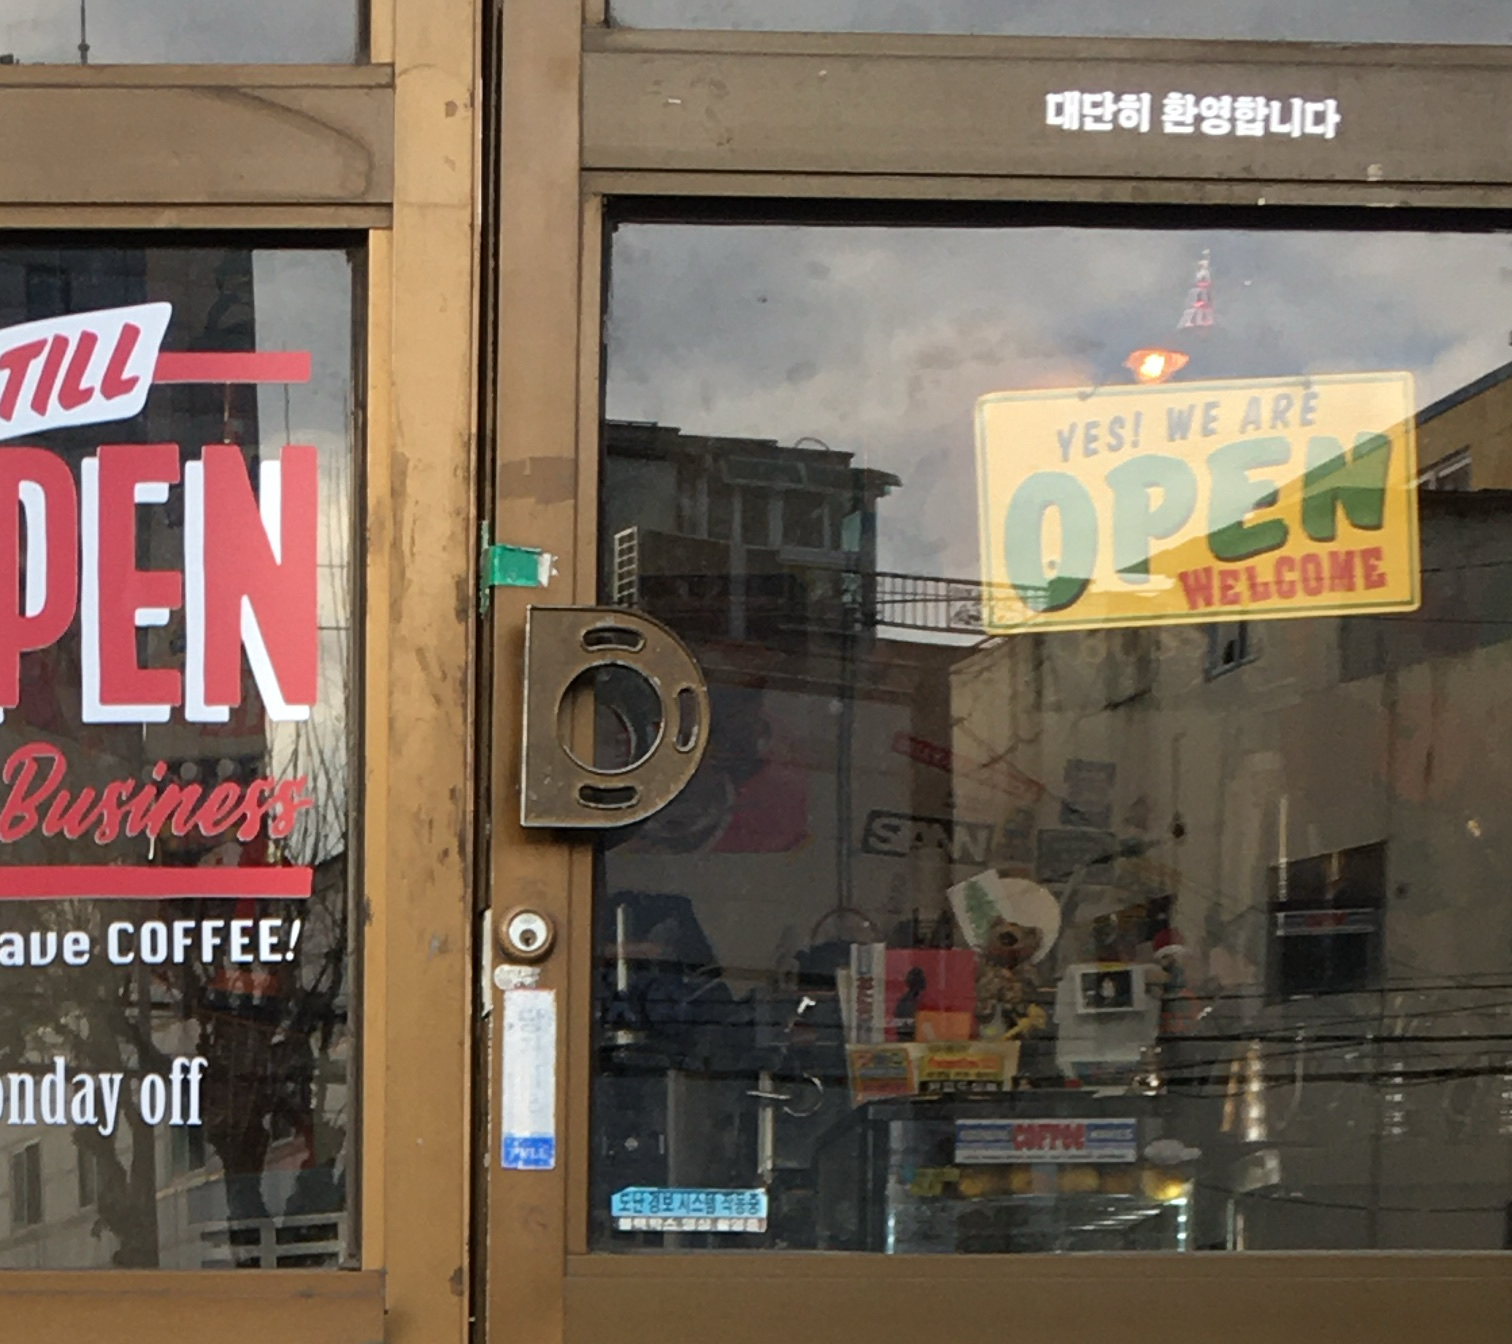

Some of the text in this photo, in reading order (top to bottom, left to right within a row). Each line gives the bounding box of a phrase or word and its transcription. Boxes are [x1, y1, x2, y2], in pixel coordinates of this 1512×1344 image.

[1045, 91, 1341, 138] 대단히 환영합니다
[1056, 389, 1321, 462] YES! WE ARE
[1003, 431, 1394, 613] OPEN
[1178, 546, 1388, 611] WELCOME
[107, 919, 303, 963] COFFEE!
[140, 1056, 209, 1127] off
